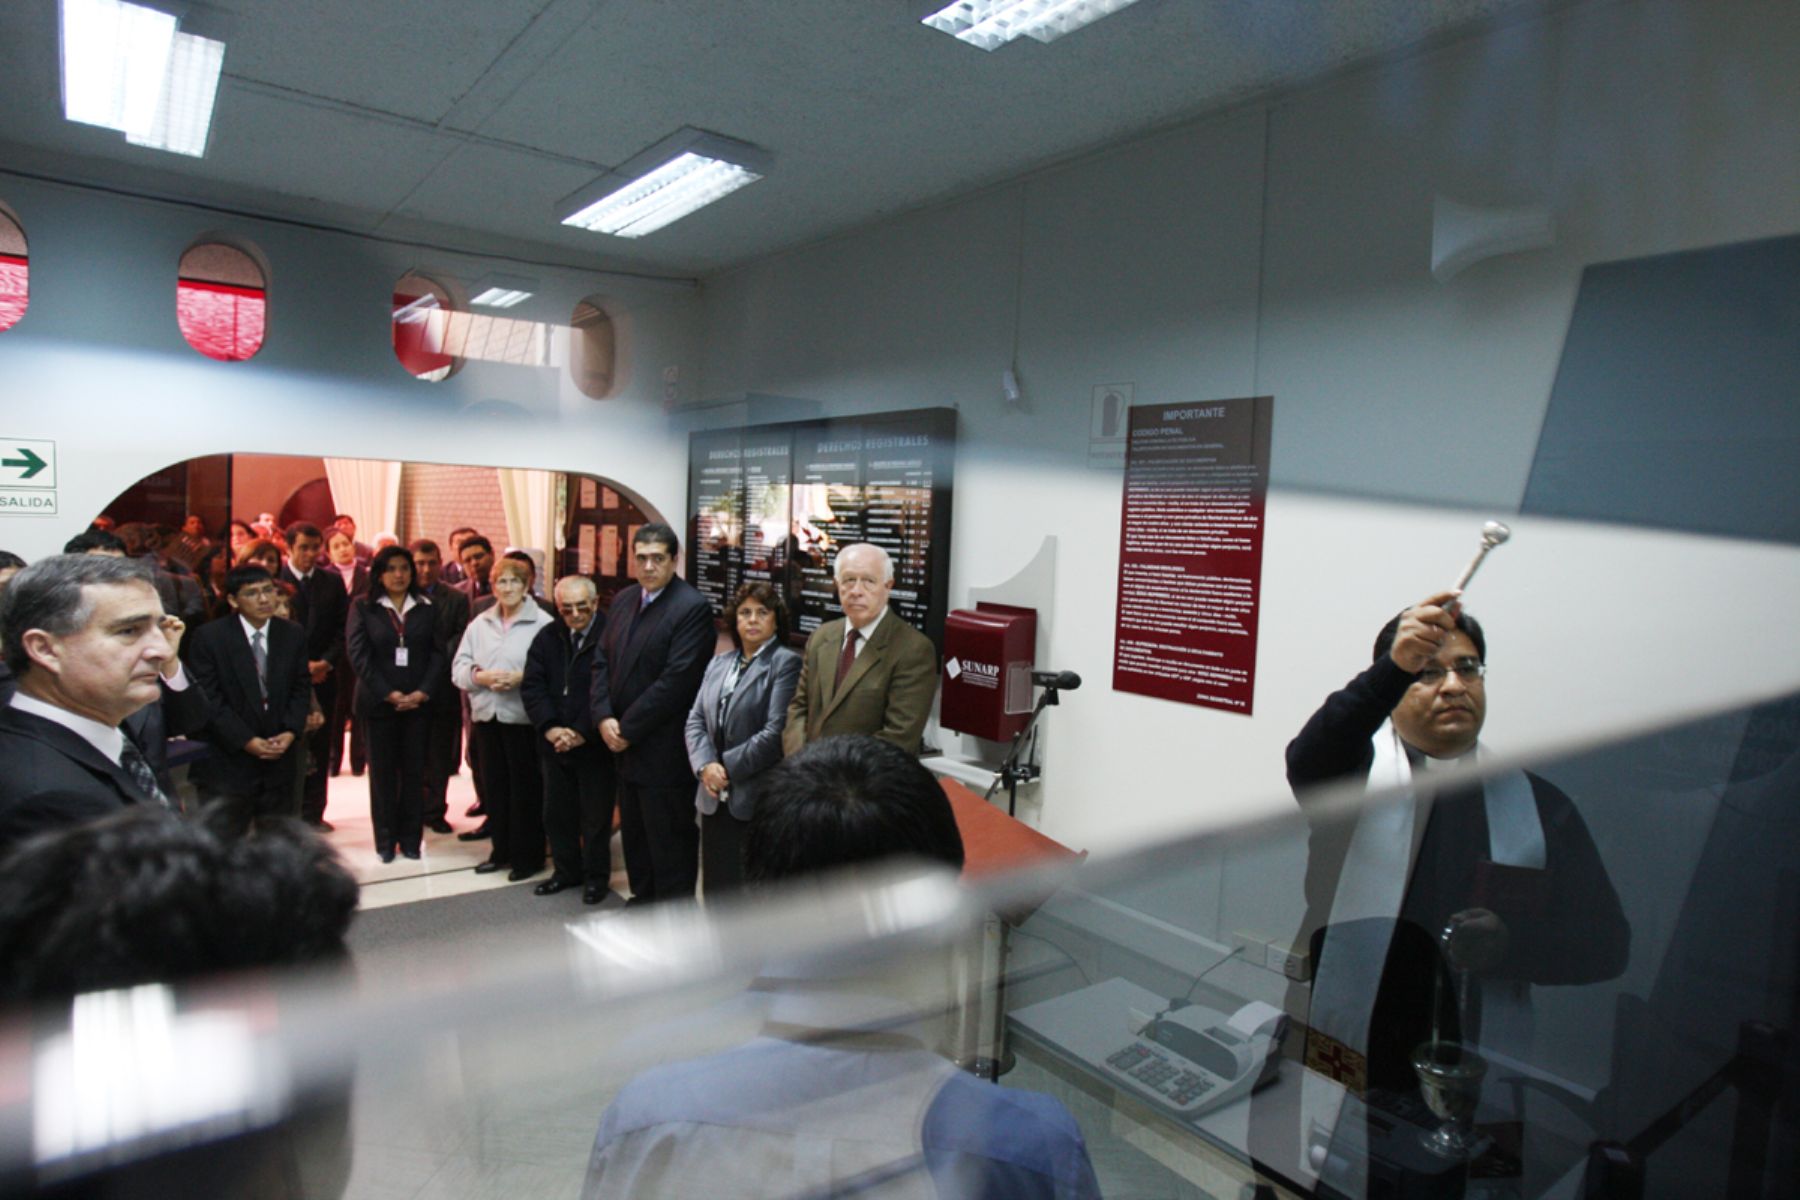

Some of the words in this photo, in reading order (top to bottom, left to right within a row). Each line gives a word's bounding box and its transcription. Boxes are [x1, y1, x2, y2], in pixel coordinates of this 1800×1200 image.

[1162, 407, 1226, 421] IMPORTANTE
[743, 445, 789, 458] REGISTRALES
[817, 440, 863, 454] DERECHOS
[865, 435, 929, 450] REGISTRALES
[0, 496, 54, 508] SALIDA
[962, 659, 1000, 677] SUNARP
